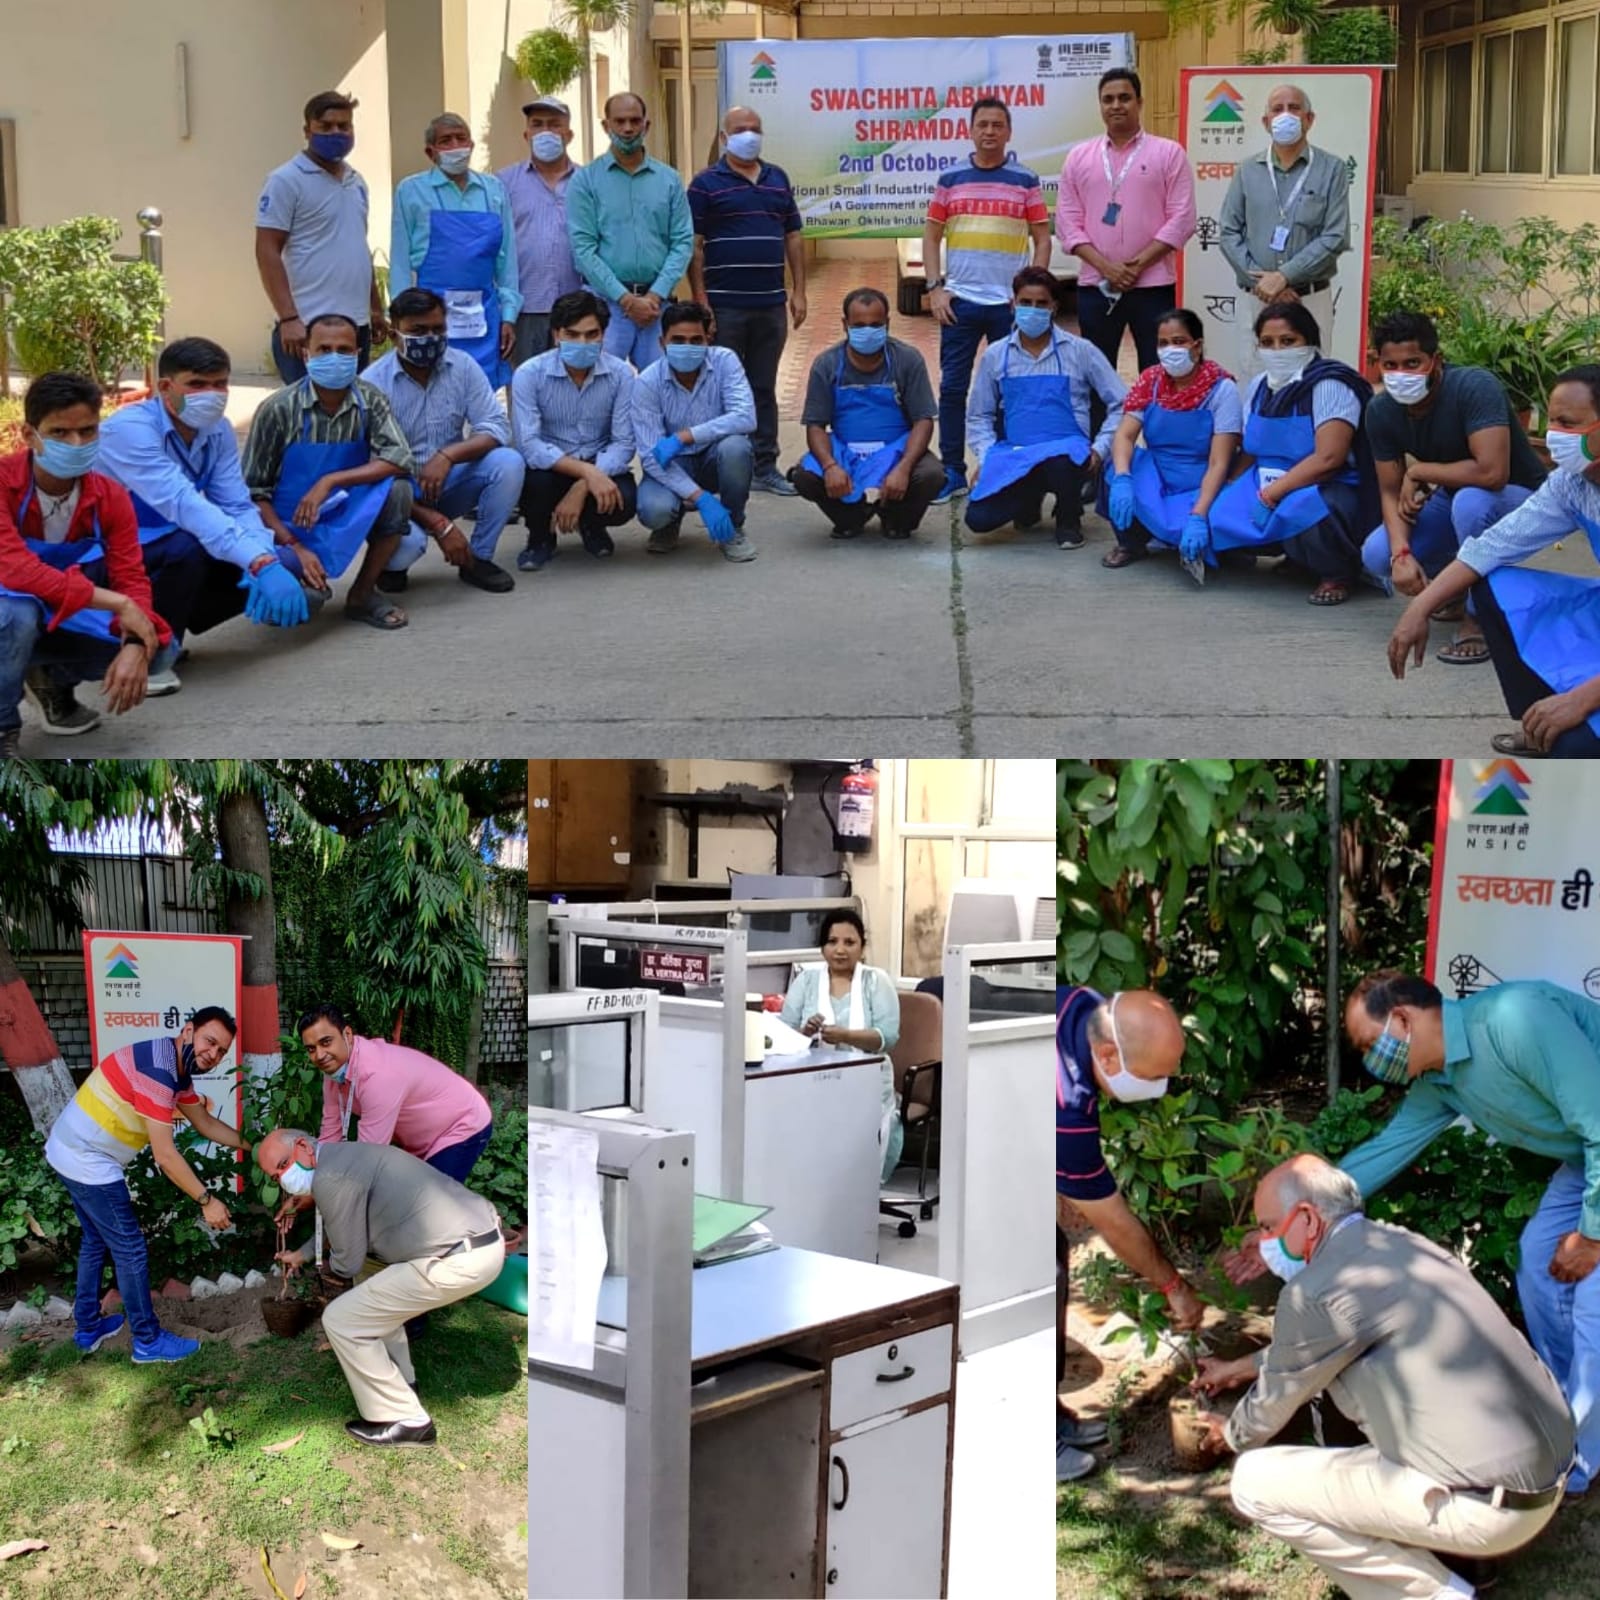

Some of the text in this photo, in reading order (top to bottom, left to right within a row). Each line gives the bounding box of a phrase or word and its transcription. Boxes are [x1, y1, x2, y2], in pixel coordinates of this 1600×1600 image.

[810, 84, 1045, 112] SWACHHTA ABHIYAN
[855, 118, 973, 142] SHRAMDA
[839, 153, 875, 173] 2nd
[881, 150, 958, 173] October
[833, 183, 871, 196] Small
[875, 182, 935, 195] Industrie
[845, 199, 916, 211] Government
[1457, 868, 1594, 910] स्वच्छता ही
[683, 971, 705, 982] GUPTA
[104, 1011, 160, 1028] स्वच्छता
[163, 1005, 180, 1029] ही
